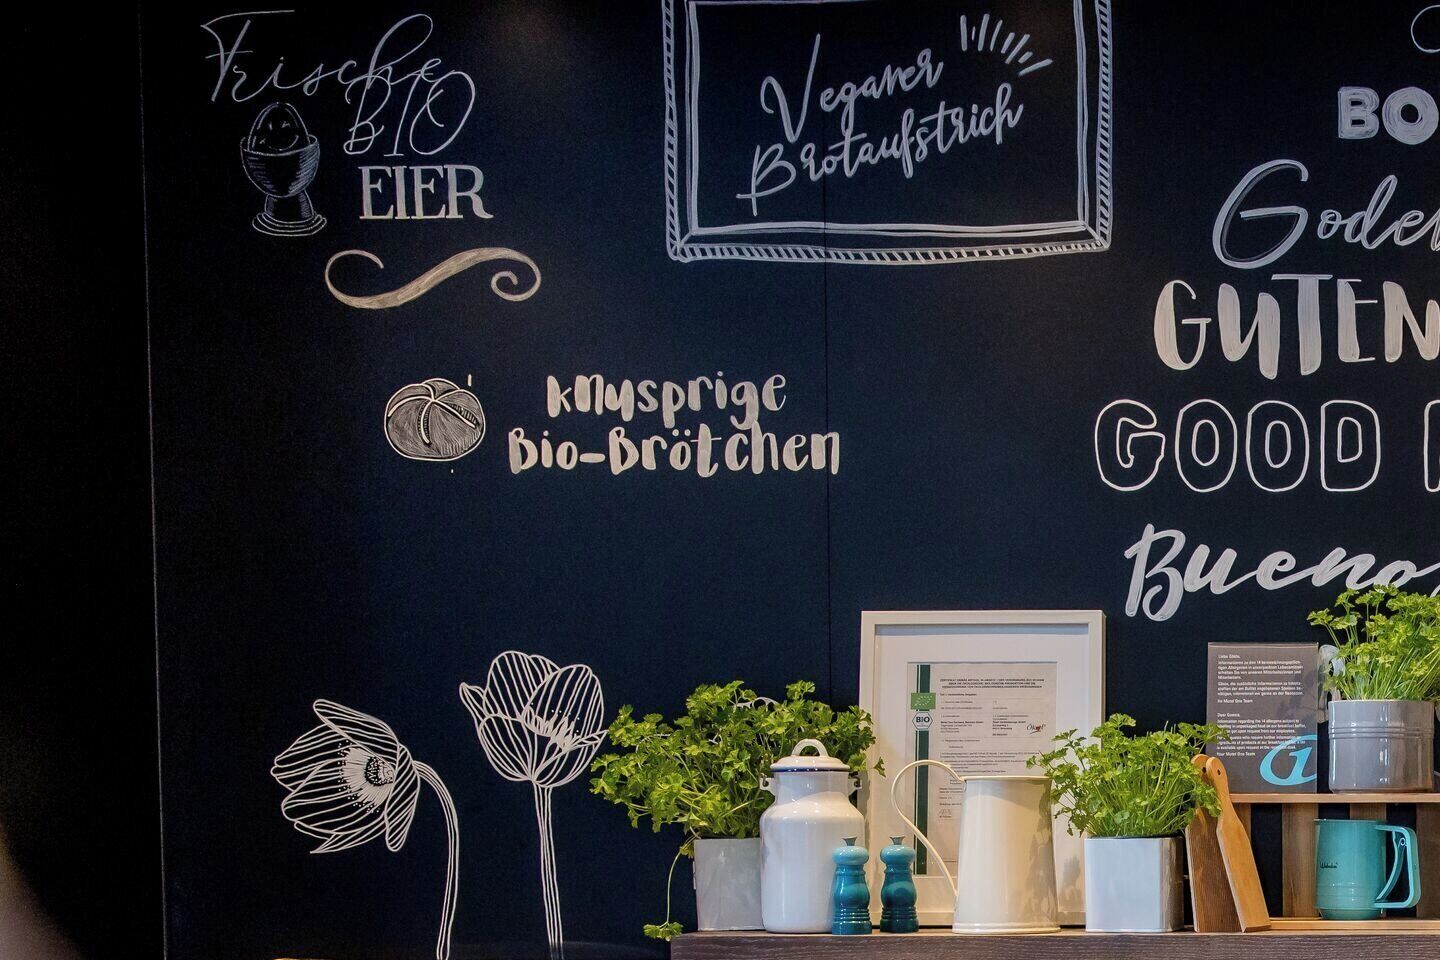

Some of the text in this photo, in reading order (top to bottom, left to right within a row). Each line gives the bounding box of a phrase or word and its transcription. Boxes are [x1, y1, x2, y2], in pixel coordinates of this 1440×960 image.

[200, 10, 440, 103] Frische
[760, 33, 944, 143] Veganer
[344, 70, 476, 157] BIO
[736, 82, 1024, 216] Brotaufstrich
[359, 165, 494, 220] EIER
[508, 421, 840, 478] Bio-Brötchen
[1094, 399, 1382, 492] GOOD
